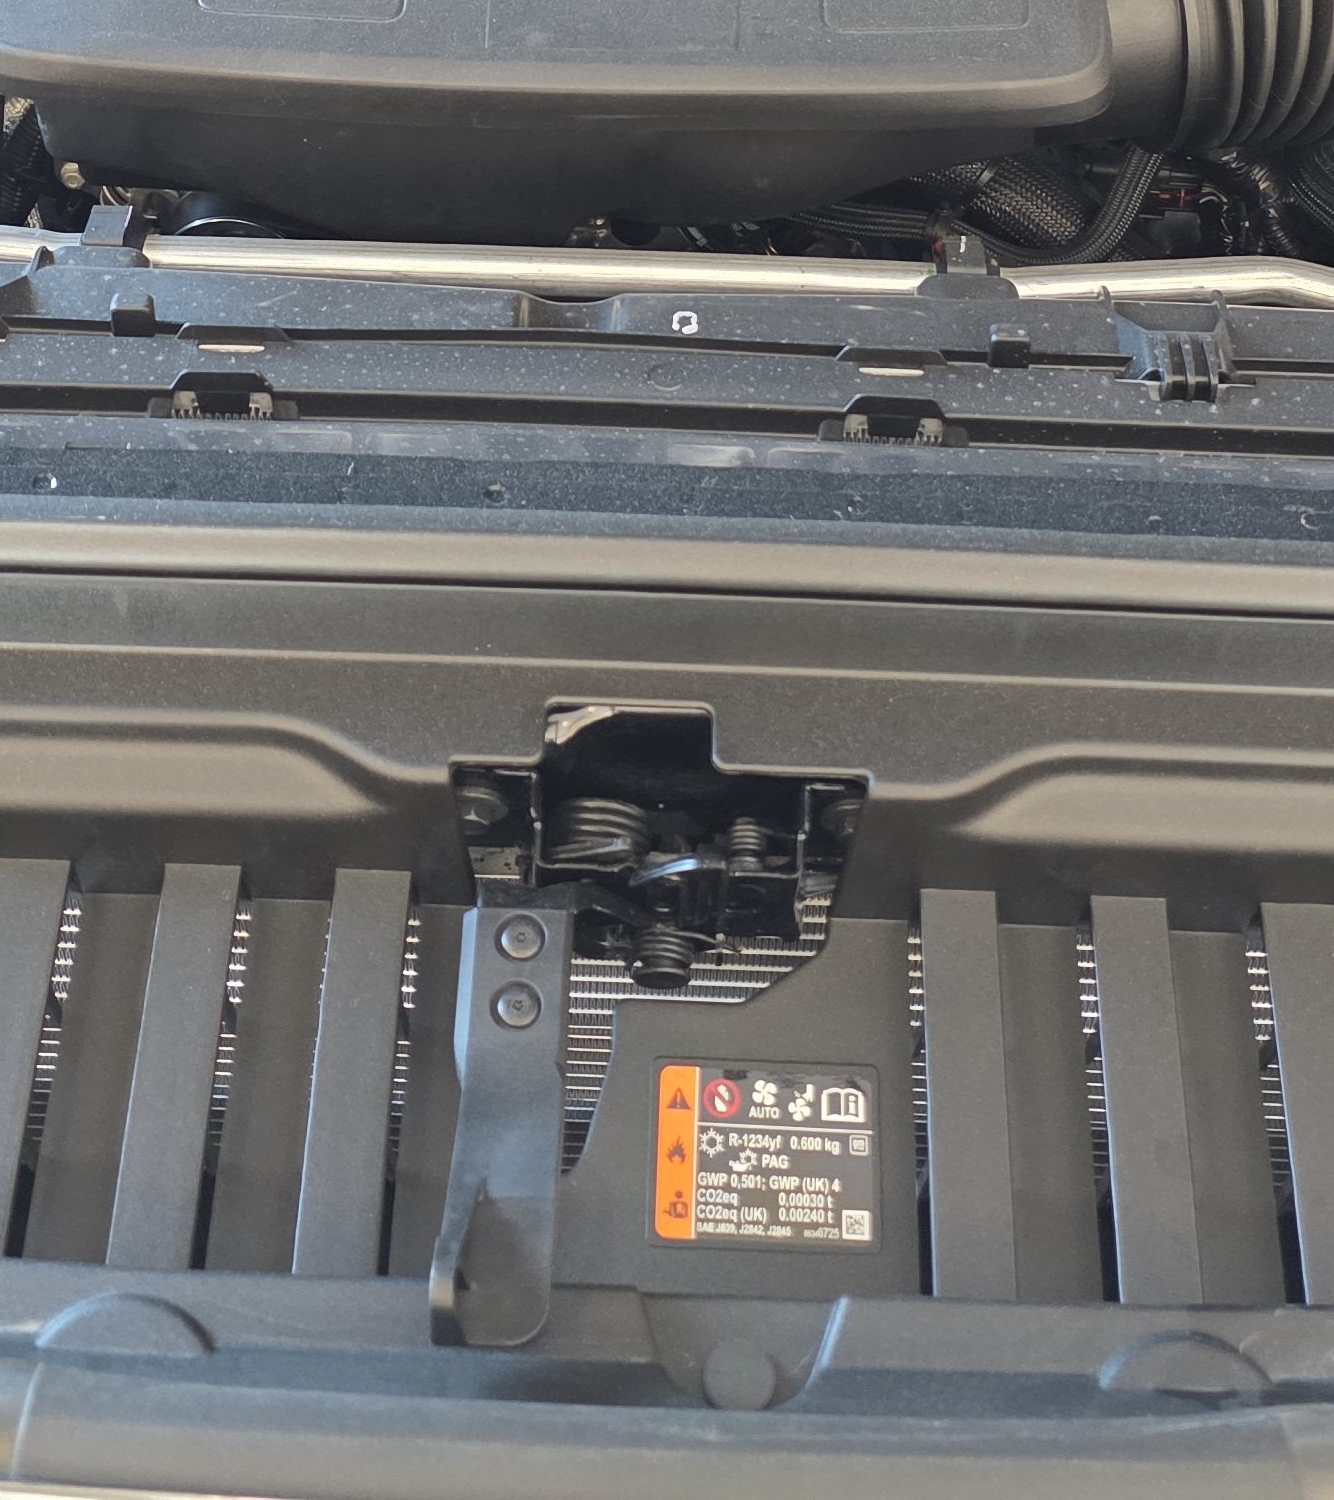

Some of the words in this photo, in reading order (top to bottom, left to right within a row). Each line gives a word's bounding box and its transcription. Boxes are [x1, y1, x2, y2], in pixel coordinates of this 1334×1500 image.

[749, 1106, 780, 1119] AUTO
[728, 1132, 782, 1151] R-1234yf
[790, 1135, 822, 1150] 0.600
[824, 1137, 841, 1155] kg
[762, 1154, 789, 1169] PAG
[697, 1172, 727, 1187] GWP
[769, 1176, 800, 1191] GWP
[802, 1177, 829, 1192] (UK)
[831, 1178, 841, 1192] 4
[697, 1189, 739, 1206] CO2eq
[827, 1194, 834, 1209] t
[697, 1205, 739, 1222] CO2eq
[740, 1207, 767, 1224] (UK)
[827, 1210, 834, 1223] t
[696, 1222, 716, 1233] SAE
